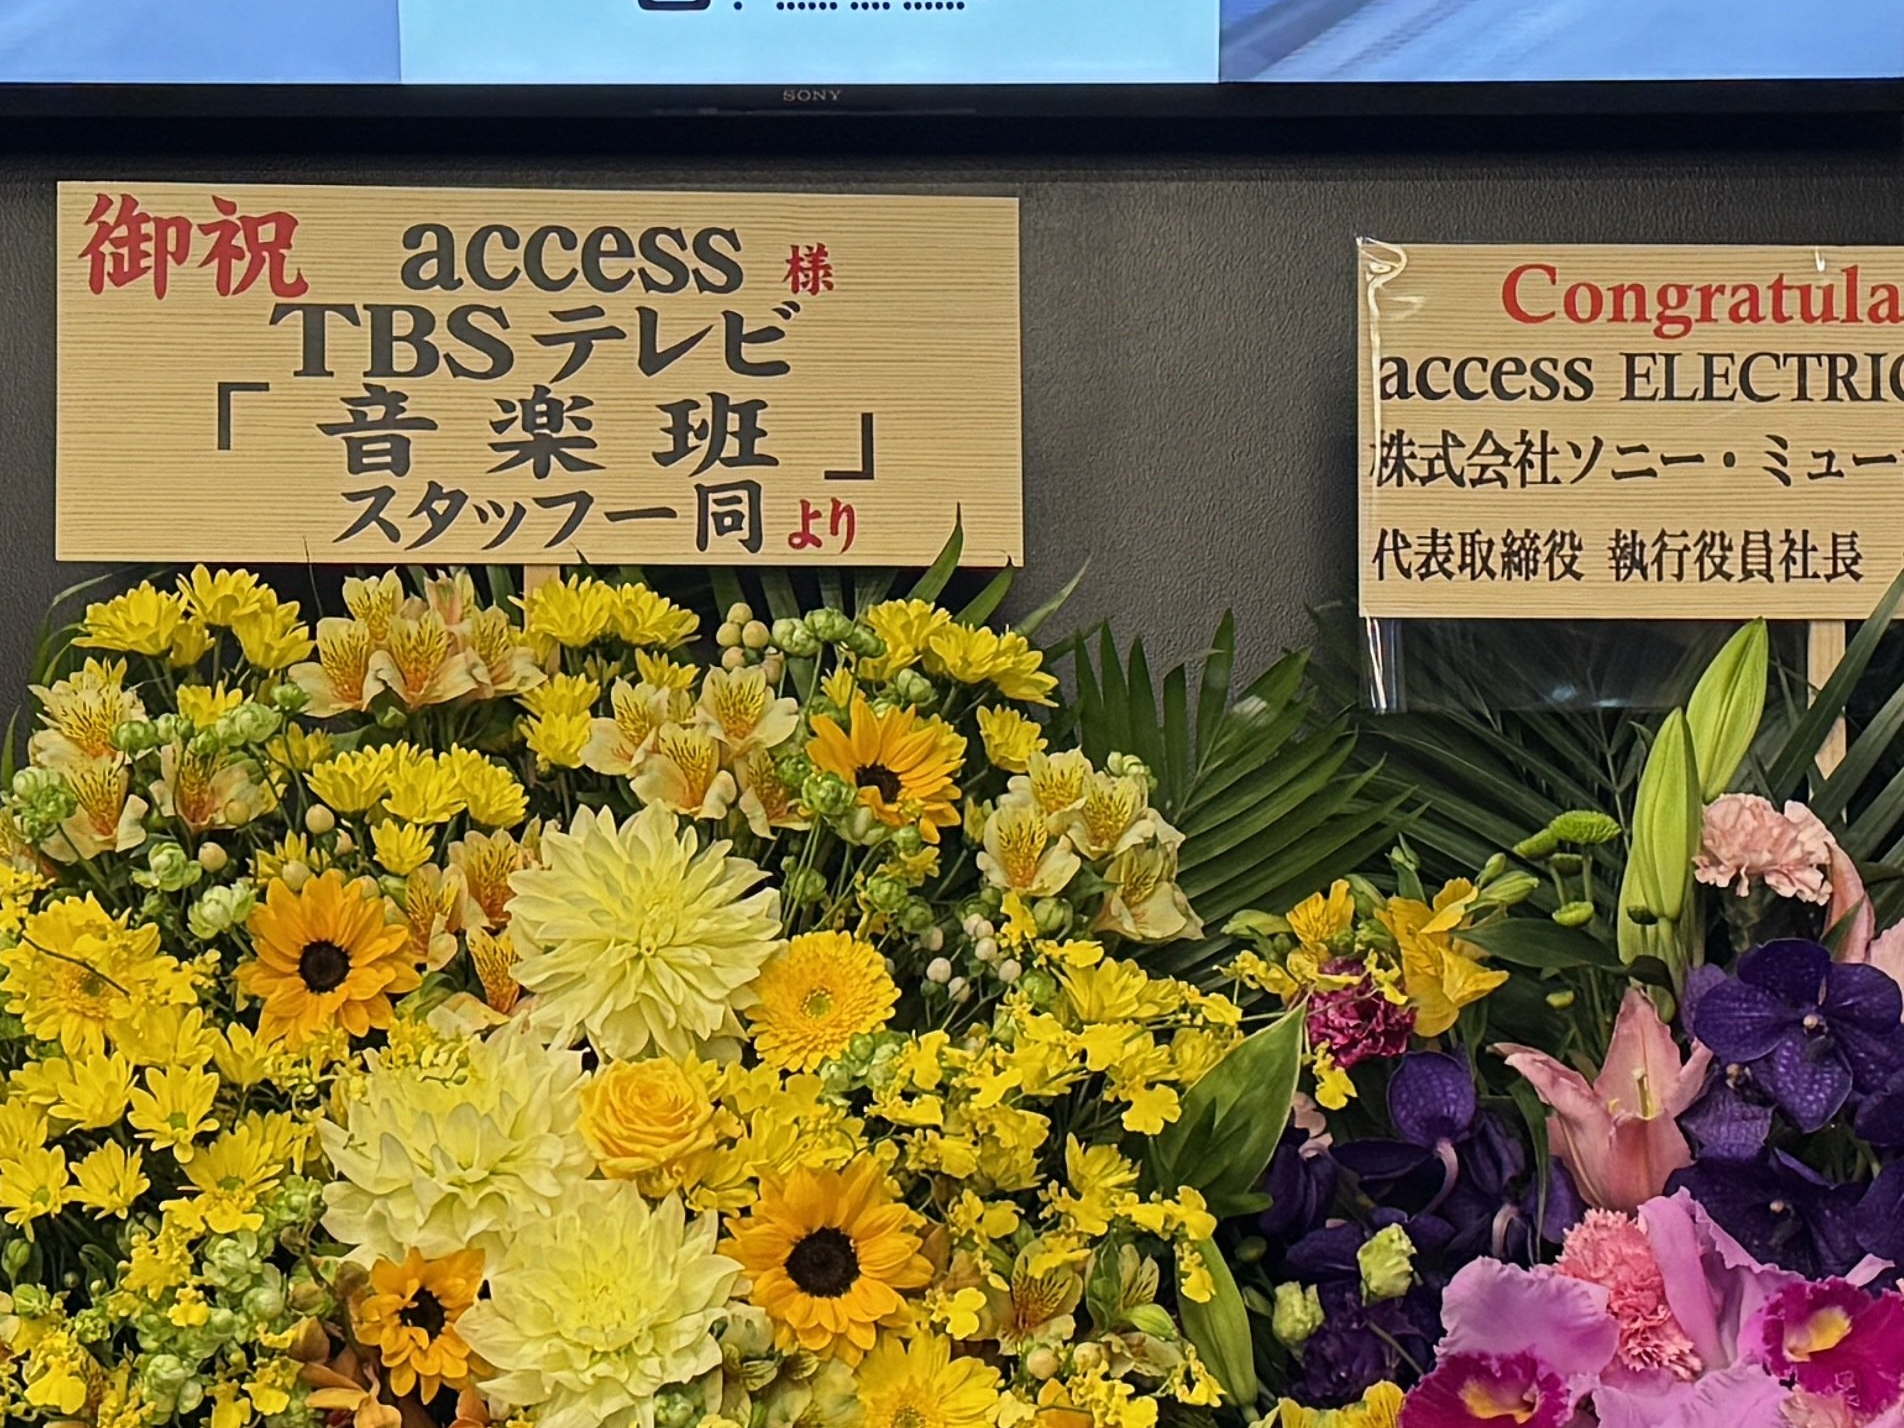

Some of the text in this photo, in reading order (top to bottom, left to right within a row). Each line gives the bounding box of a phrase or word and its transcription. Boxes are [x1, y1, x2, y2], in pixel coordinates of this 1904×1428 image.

[783, 89, 841, 101] SONY
[77, 195, 837, 299] 御祝 access 様
[267, 299, 801, 384] TBSテレビ
[1379, 356, 1594, 402] access
[1371, 527, 1585, 582] 代表取締役
[1607, 528, 1864, 584] 執行役員社長
